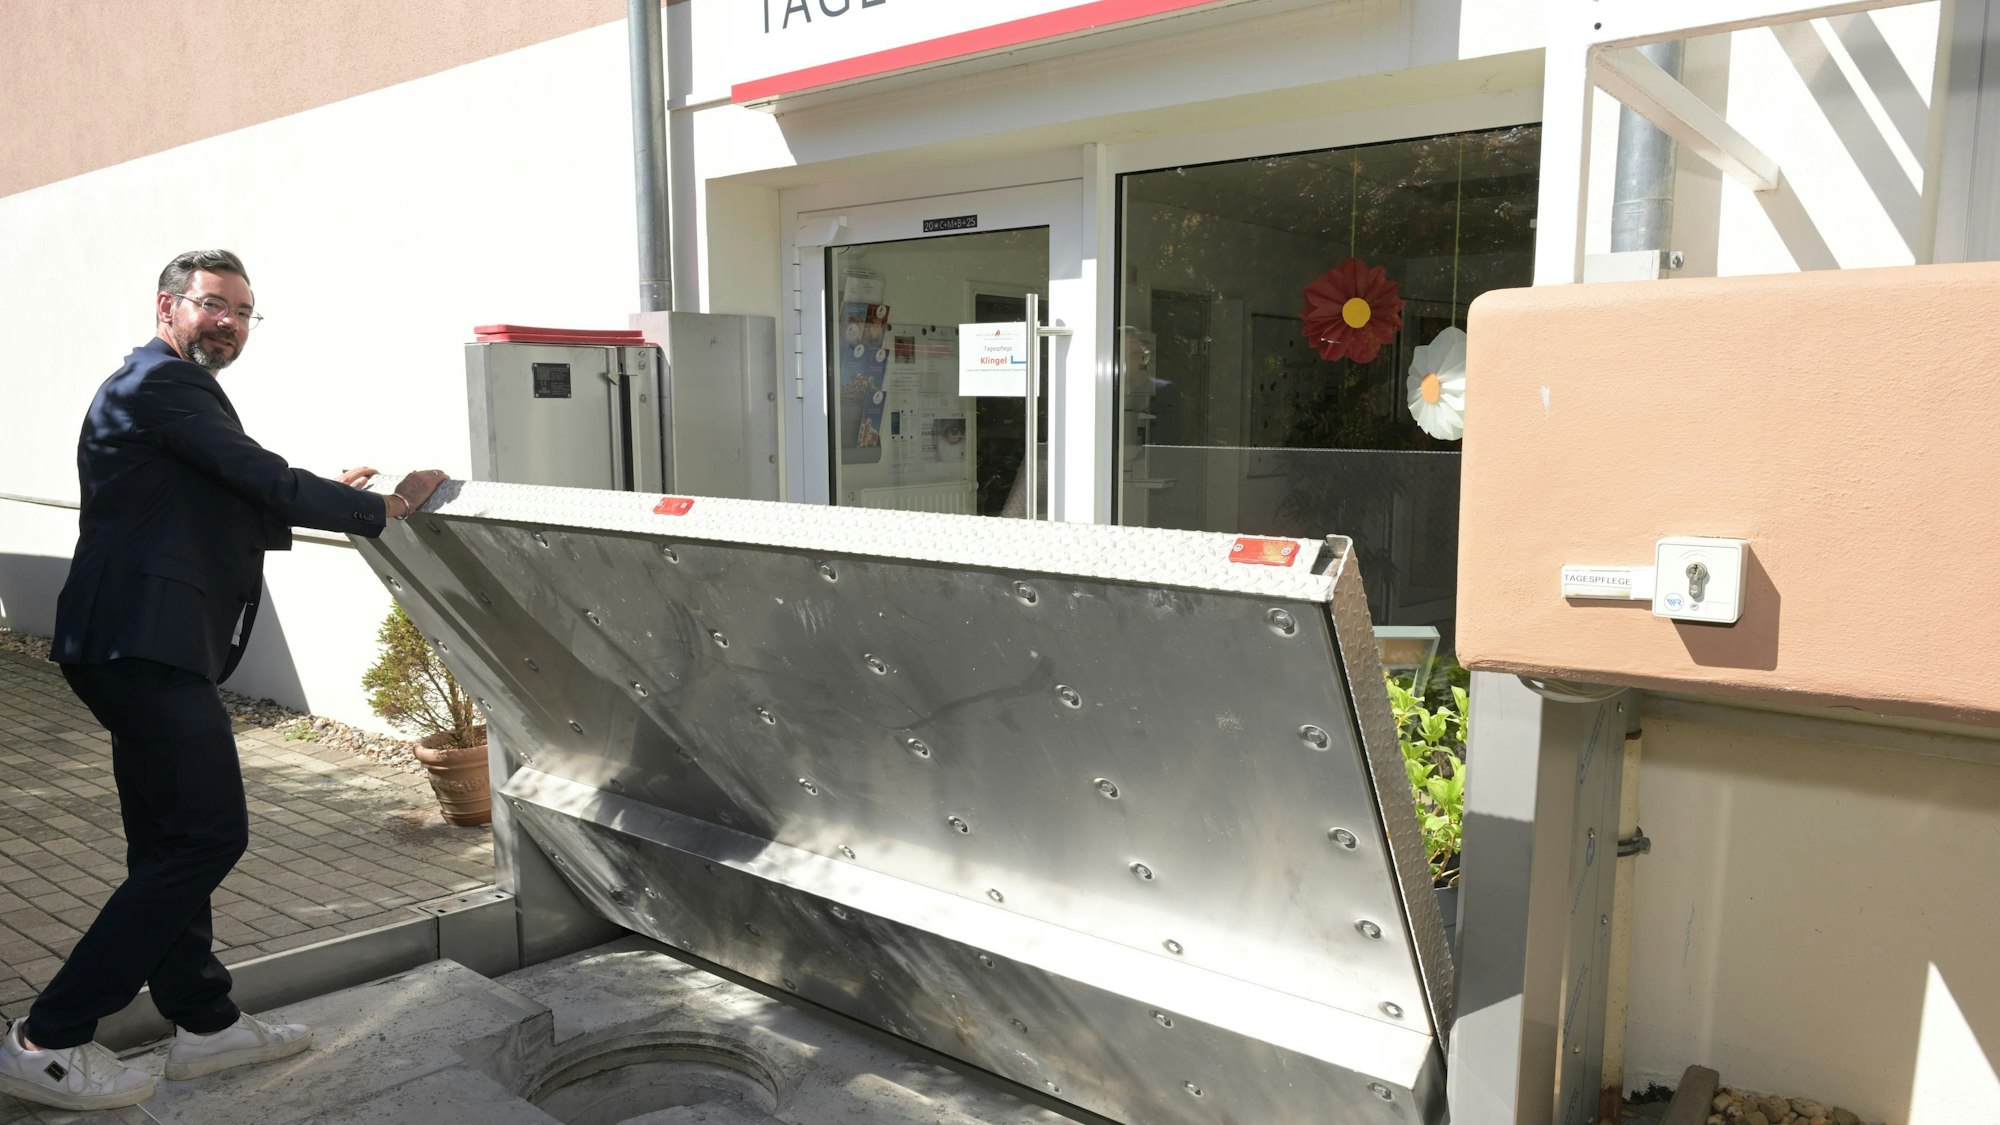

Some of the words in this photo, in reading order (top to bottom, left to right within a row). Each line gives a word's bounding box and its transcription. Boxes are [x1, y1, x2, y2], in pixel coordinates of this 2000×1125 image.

[984, 345, 1013, 353] Tagespflege
[980, 356, 1008, 366] Klingel
[1564, 574, 1632, 586] TAGESPFLEGE
